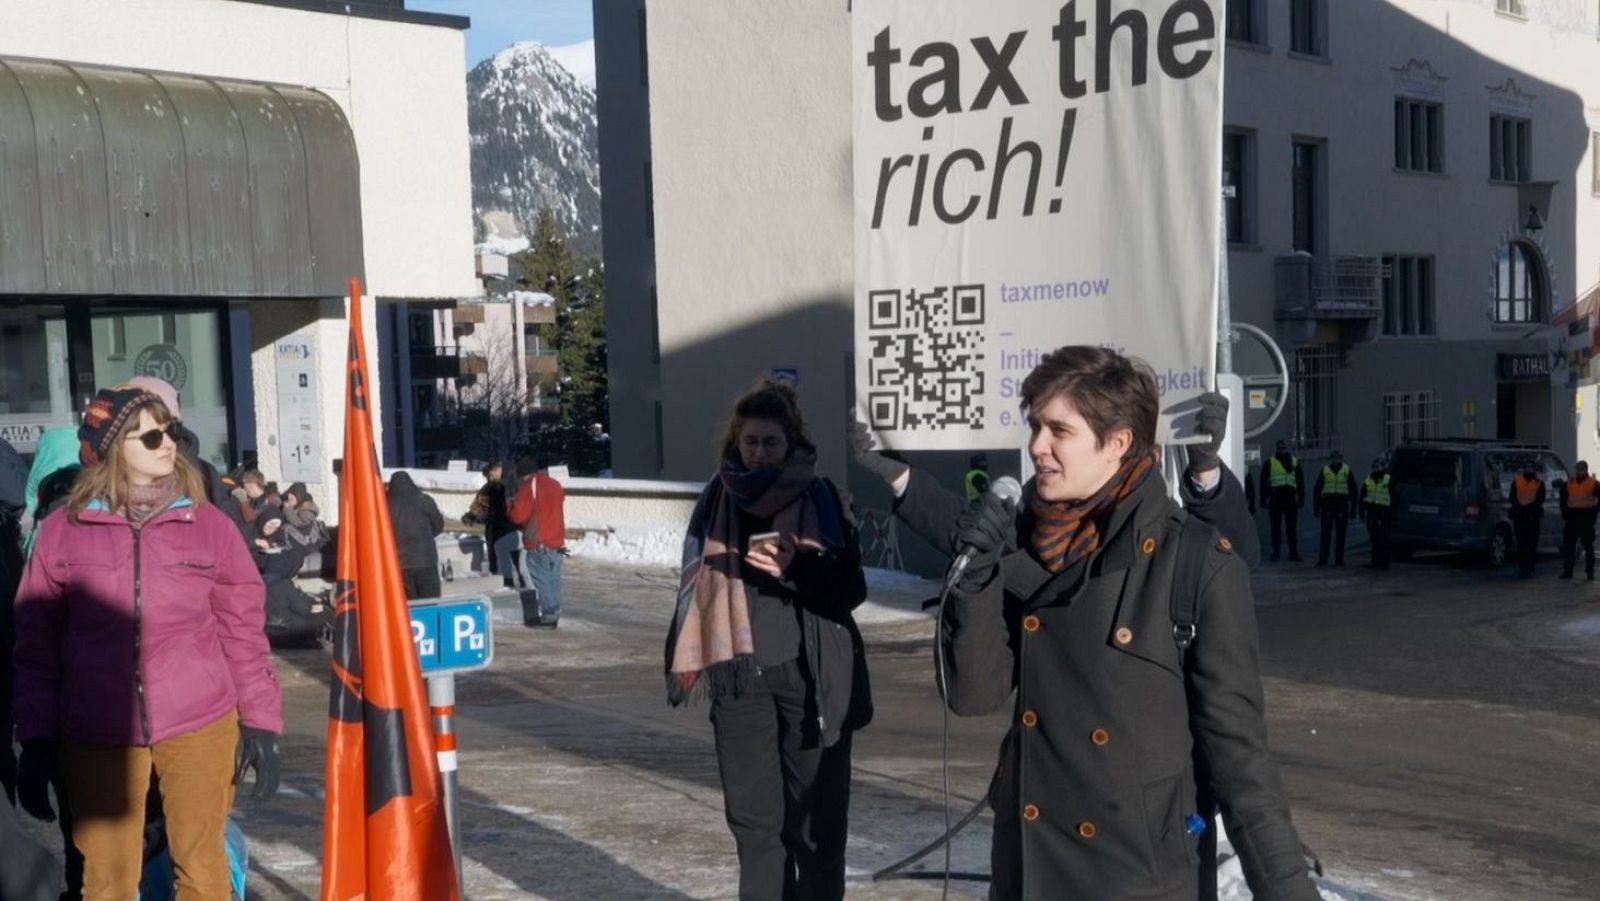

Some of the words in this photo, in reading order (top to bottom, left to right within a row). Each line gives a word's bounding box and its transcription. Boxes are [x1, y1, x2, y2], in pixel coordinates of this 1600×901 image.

[867, 25, 1030, 122] tax
[1052, 0, 1215, 99] the
[871, 108, 1077, 229] rich!
[1000, 278, 1109, 303] taxmenow
[1000, 347, 1040, 370] Initi
[1157, 366, 1206, 396] gkeit
[1, 425, 30, 438] ATIA
[454, 614, 475, 652] P
